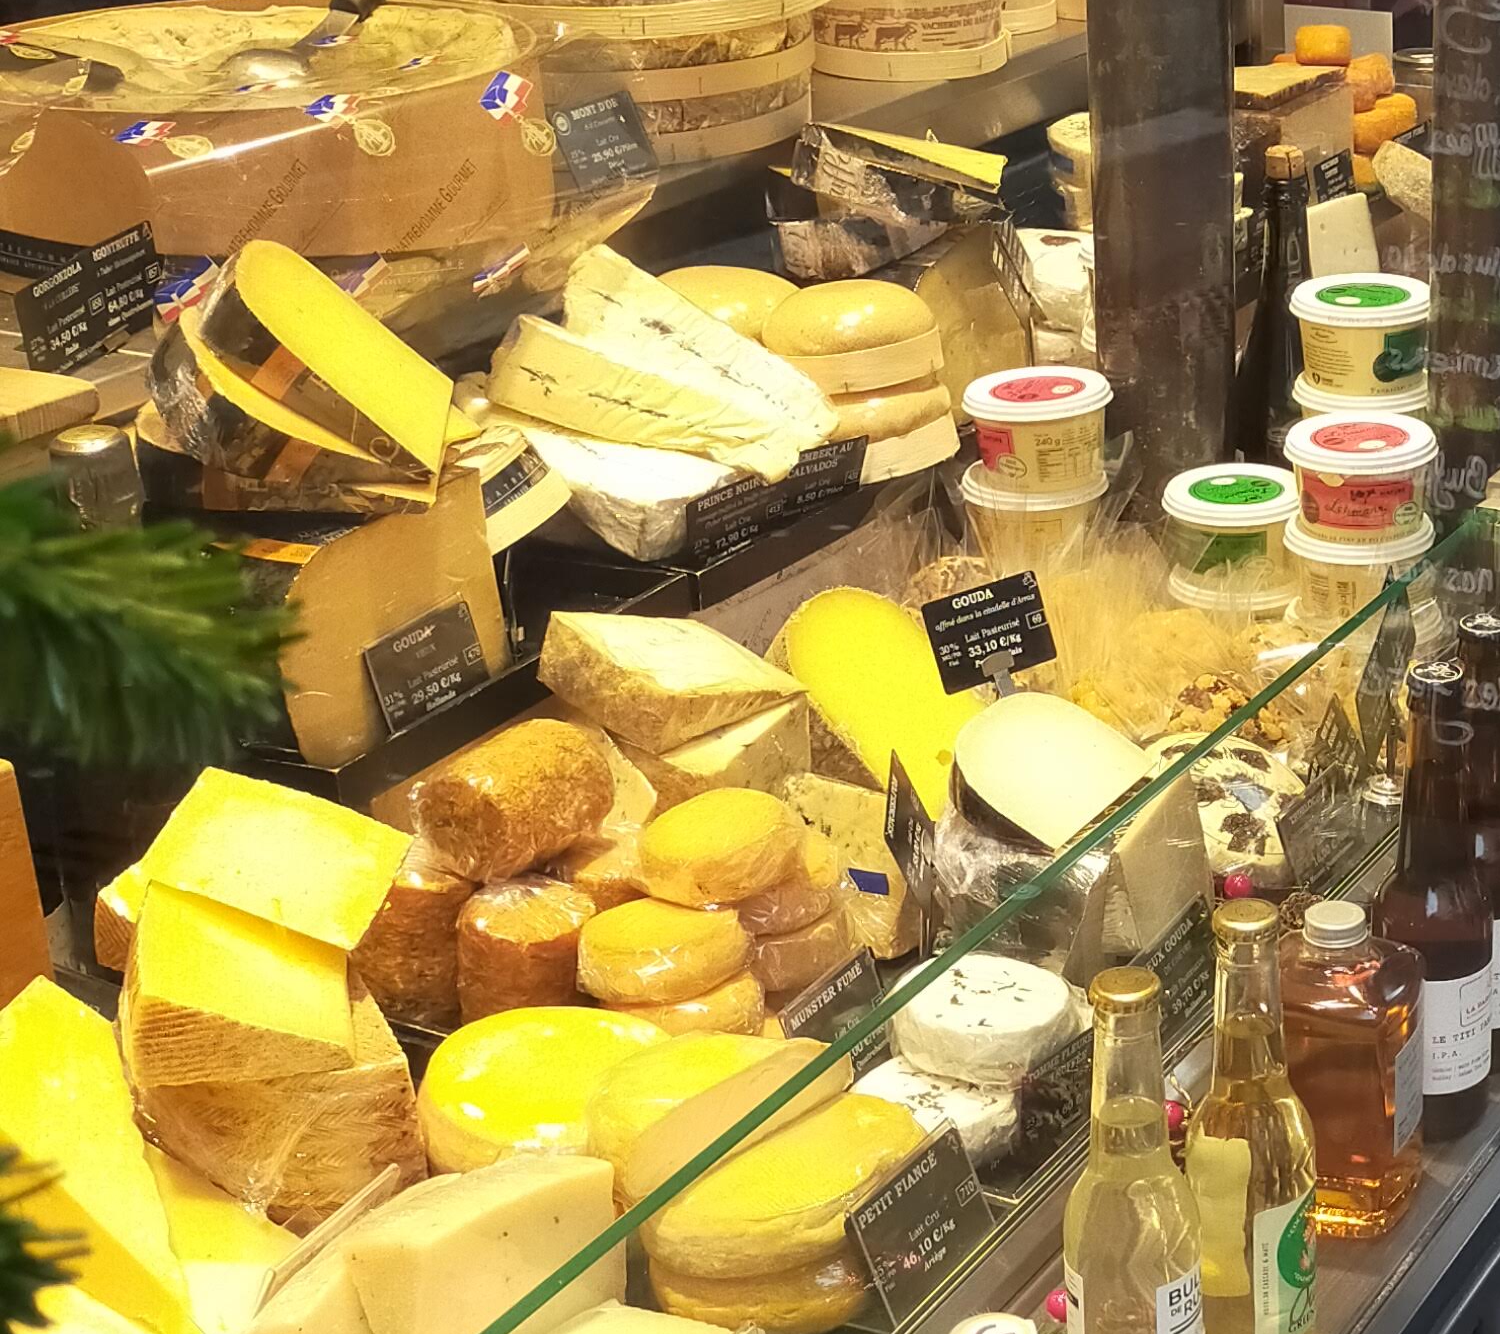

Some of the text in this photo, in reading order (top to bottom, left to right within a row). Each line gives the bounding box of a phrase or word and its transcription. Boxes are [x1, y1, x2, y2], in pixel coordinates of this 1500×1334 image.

[570, 97, 619, 121] MONT D'OR
[268, 158, 311, 206] GOURMET
[438, 157, 480, 204] GOURMET
[32, 260, 83, 298] GORGONZOLA
[49, 330, 72, 352] 34,50
[839, 441, 855, 455] AU
[1034, 436, 1053, 447] 240
[787, 457, 839, 479] CALVADOS
[697, 476, 761, 512] PRINCE NOIR
[951, 587, 995, 610] GOUDA
[392, 626, 434, 654] GOUDA
[964, 617, 1021, 644] Lait Pasteurisé
[967, 633, 1022, 659] 33,10 €/Kg
[411, 681, 440, 705] 29,50
[1163, 917, 1194, 953] GOUDA
[790, 960, 864, 1032] MUNSTER FUMÉ
[1171, 985, 1194, 1015] 39,70
[1431, 1028, 1476, 1045] LE TITI
[857, 1149, 939, 1231] PETIT FIANCÉ
[958, 1180, 975, 1200] 710
[907, 1209, 941, 1243] Lait Cru
[903, 1217, 957, 1271] 46,10 €/Kg
[923, 1245, 948, 1273] Ariège
[1170, 1306, 1182, 1317] DE
